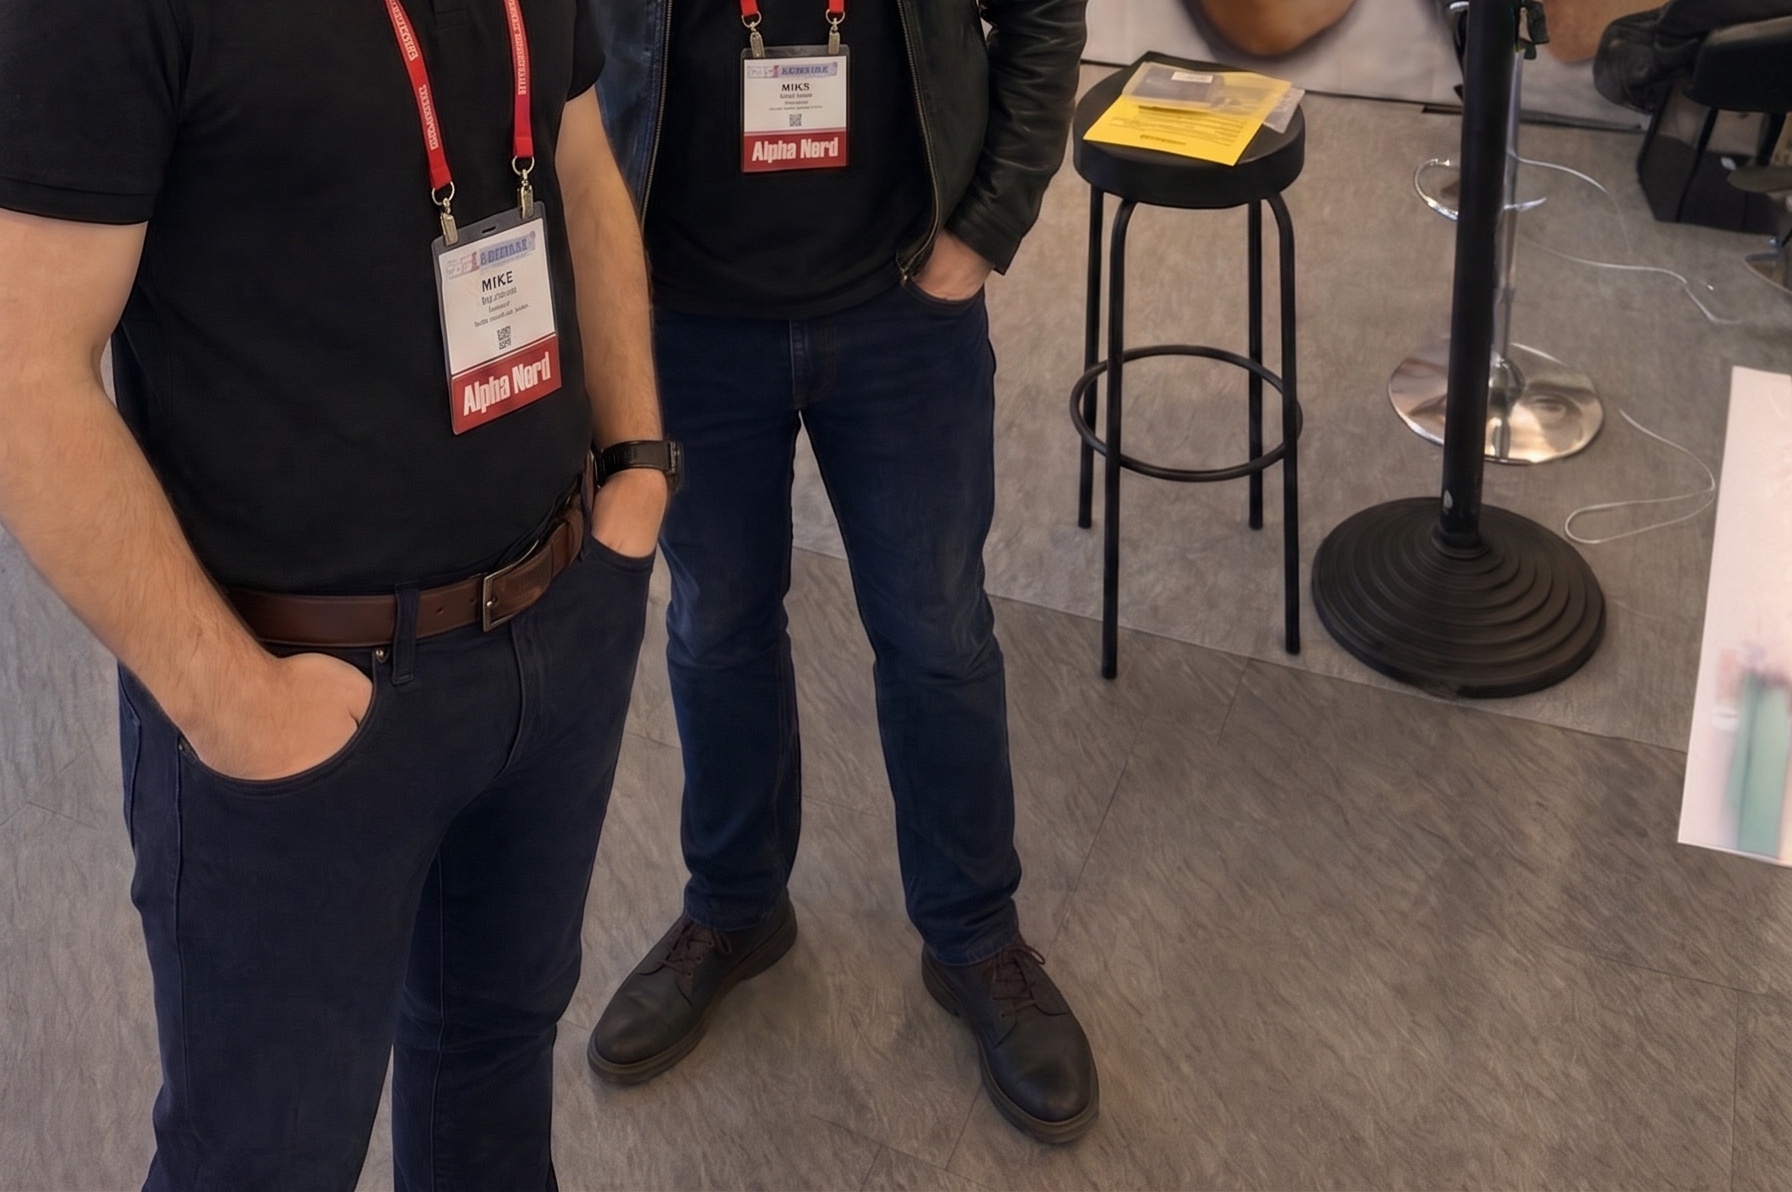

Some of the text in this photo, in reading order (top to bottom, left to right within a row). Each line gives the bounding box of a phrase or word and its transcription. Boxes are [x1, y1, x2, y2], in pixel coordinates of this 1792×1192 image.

[751, 140, 797, 164] Alpha
[481, 270, 514, 292] MIKE
[463, 372, 511, 416] Alpha
